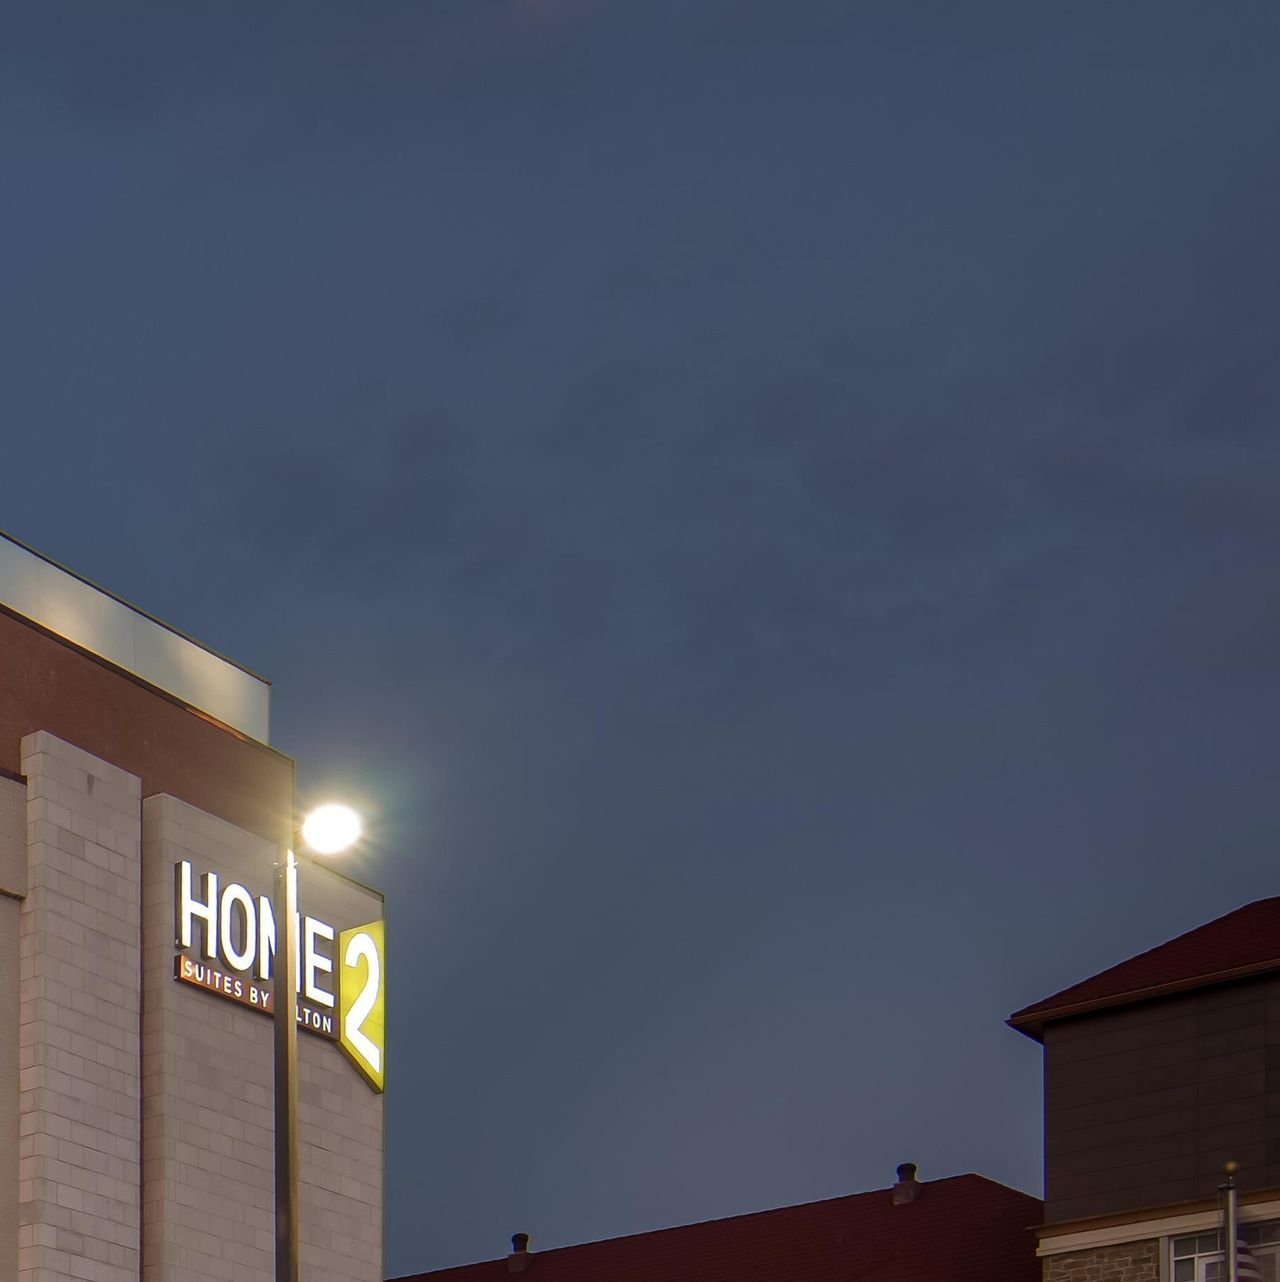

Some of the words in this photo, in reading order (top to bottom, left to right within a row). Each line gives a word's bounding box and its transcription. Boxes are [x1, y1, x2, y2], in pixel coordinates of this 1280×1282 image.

[184, 960, 243, 998] SUITES
[249, 986, 270, 1008] BY
[296, 1004, 332, 1033] LTON
[344, 932, 382, 1074] 2
